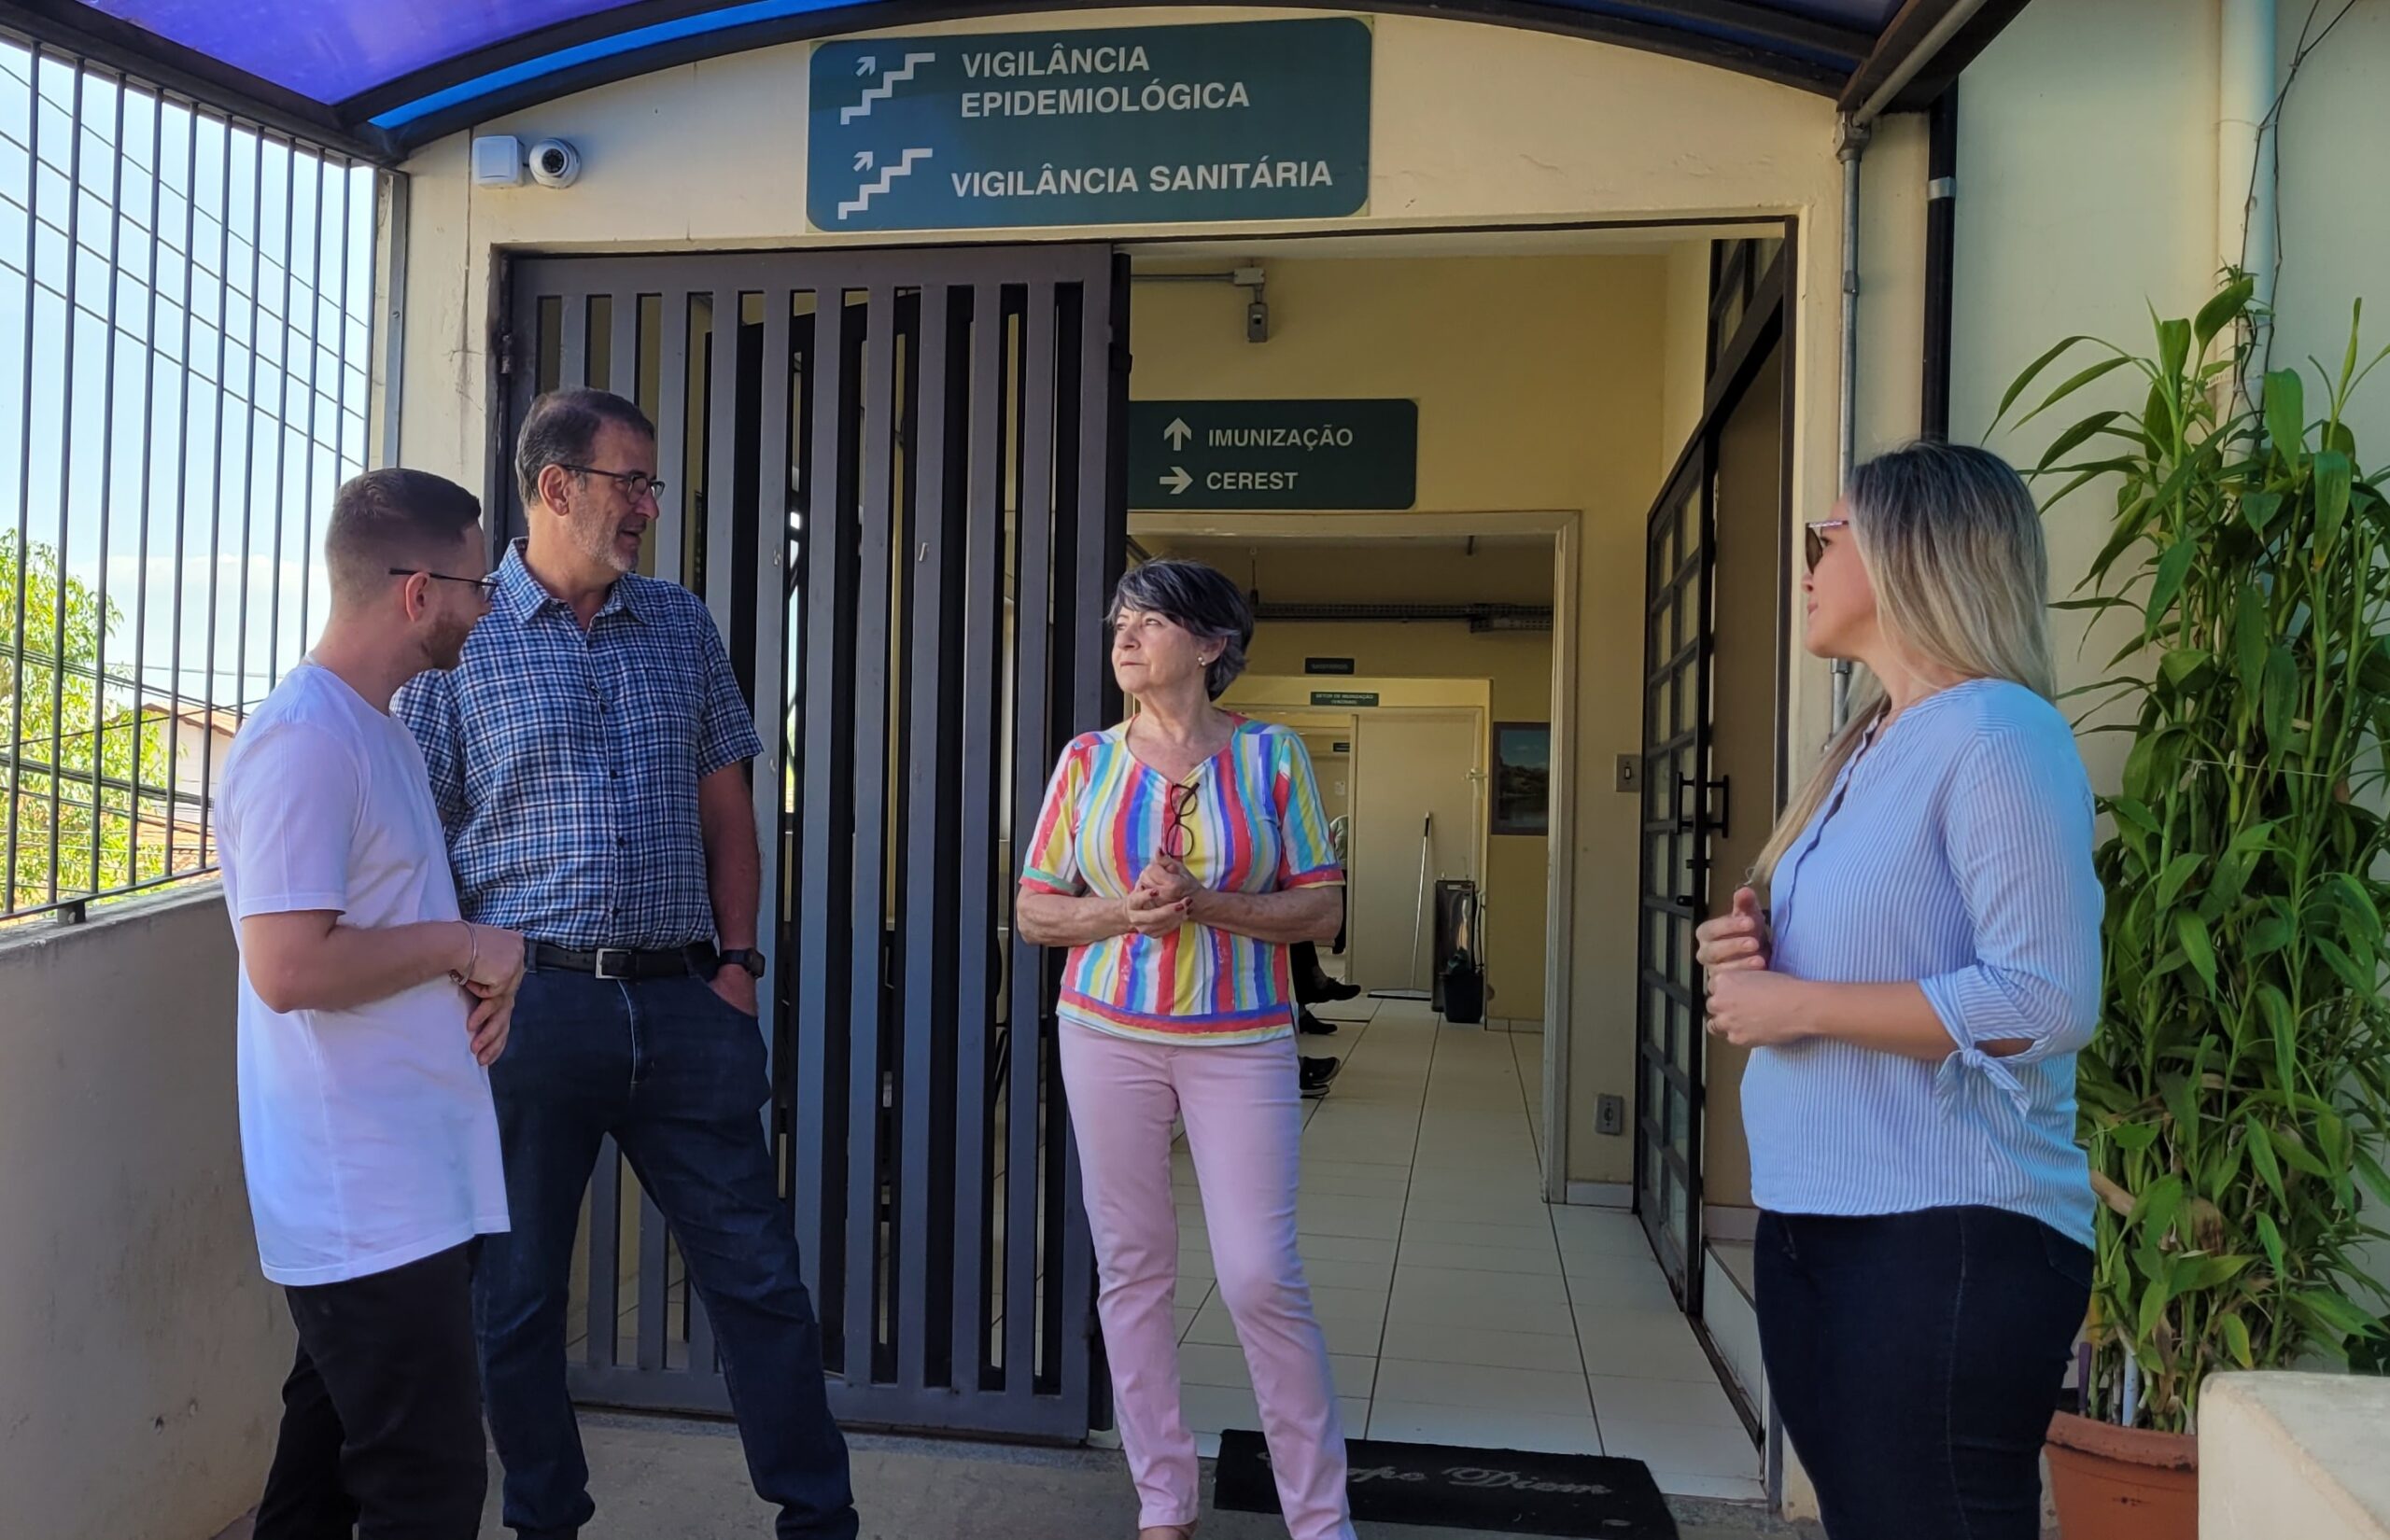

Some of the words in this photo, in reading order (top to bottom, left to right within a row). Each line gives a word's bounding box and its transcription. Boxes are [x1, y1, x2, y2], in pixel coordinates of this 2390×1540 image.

[962, 43, 1150, 78] VIGILÂNCIA
[961, 78, 1250, 118] EPIDEMIOLÓGICA
[950, 163, 1138, 198] VIGILÂNCIA
[1149, 155, 1333, 193] SANITÁRIA
[1208, 424, 1354, 451] IMUNIZAÇÃO
[1205, 472, 1299, 490] CEREST
